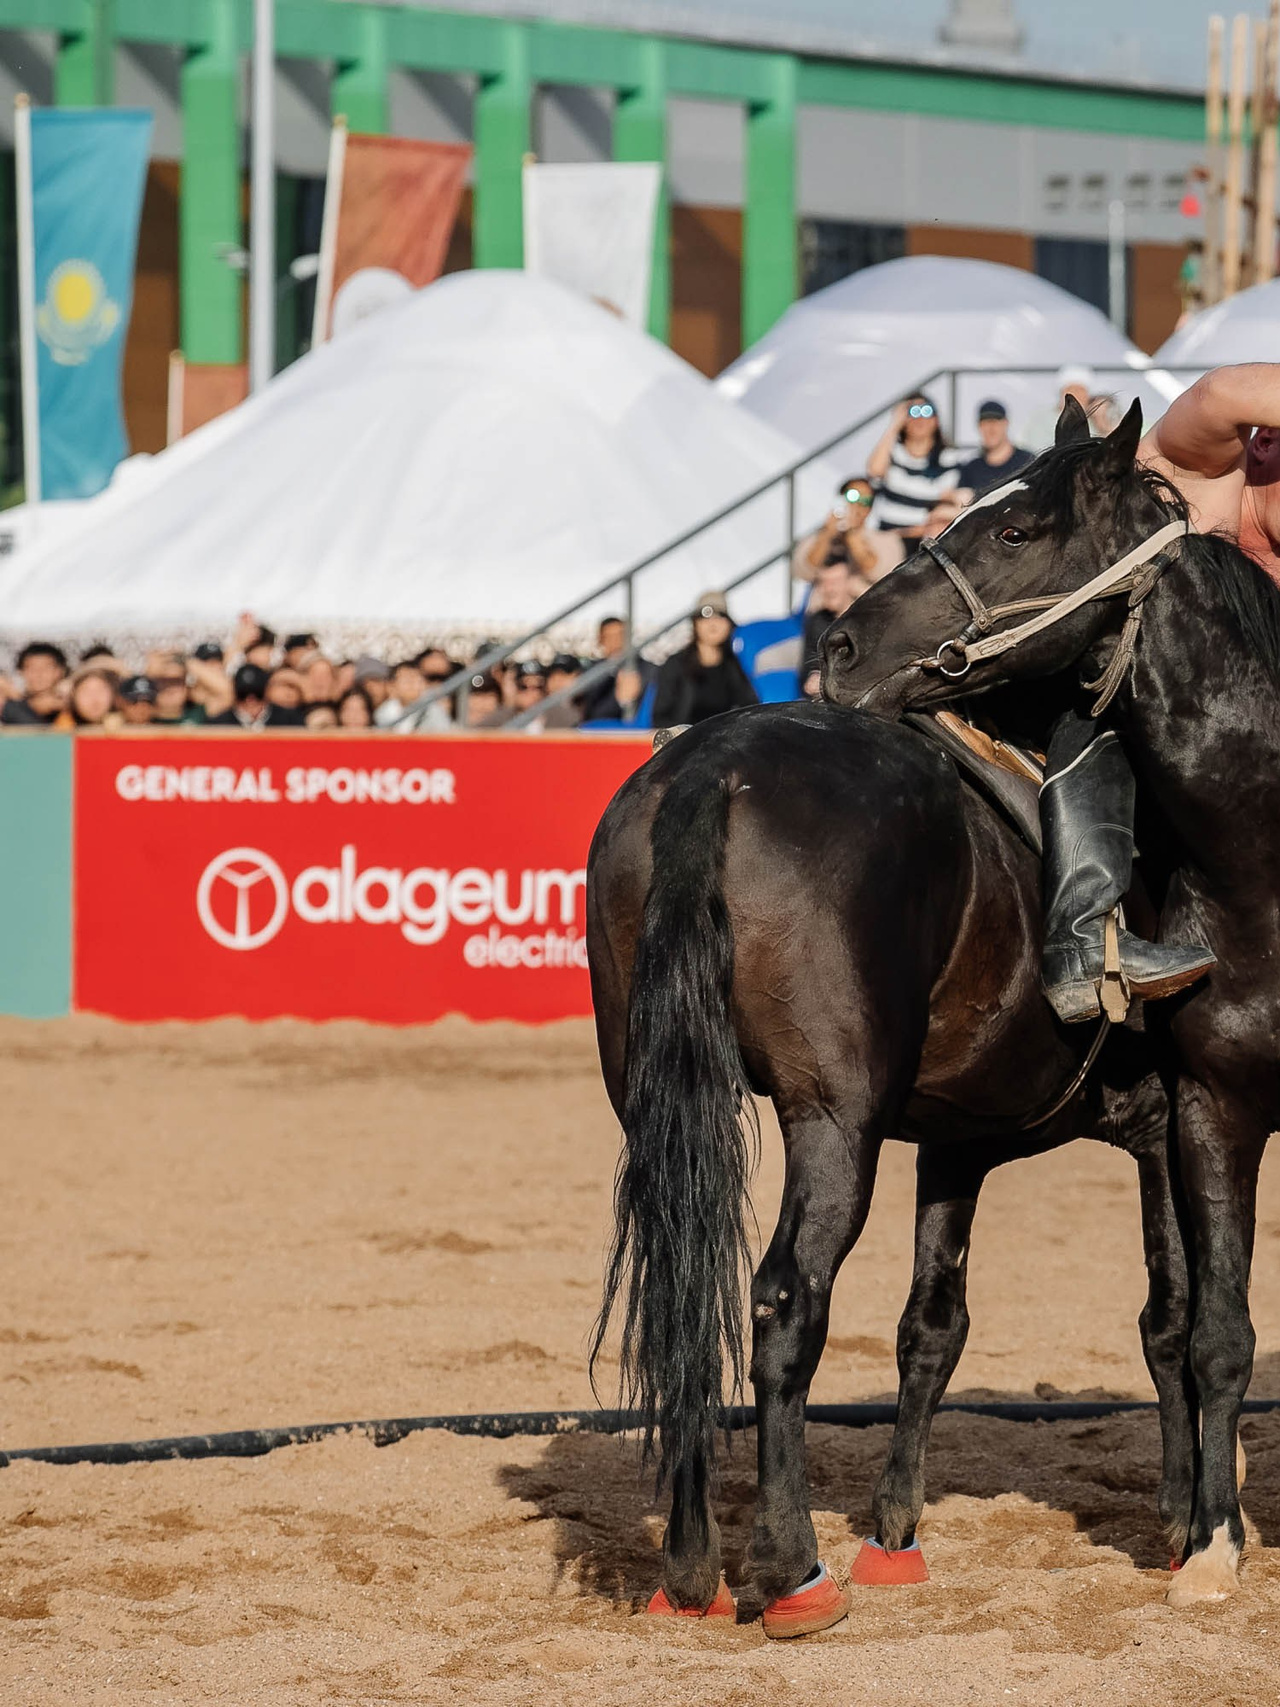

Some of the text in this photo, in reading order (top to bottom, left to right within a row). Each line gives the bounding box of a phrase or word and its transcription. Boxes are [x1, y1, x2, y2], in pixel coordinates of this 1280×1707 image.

[115, 765, 457, 804] GENERAL SPONSOR
[291, 843, 587, 946] alageum
